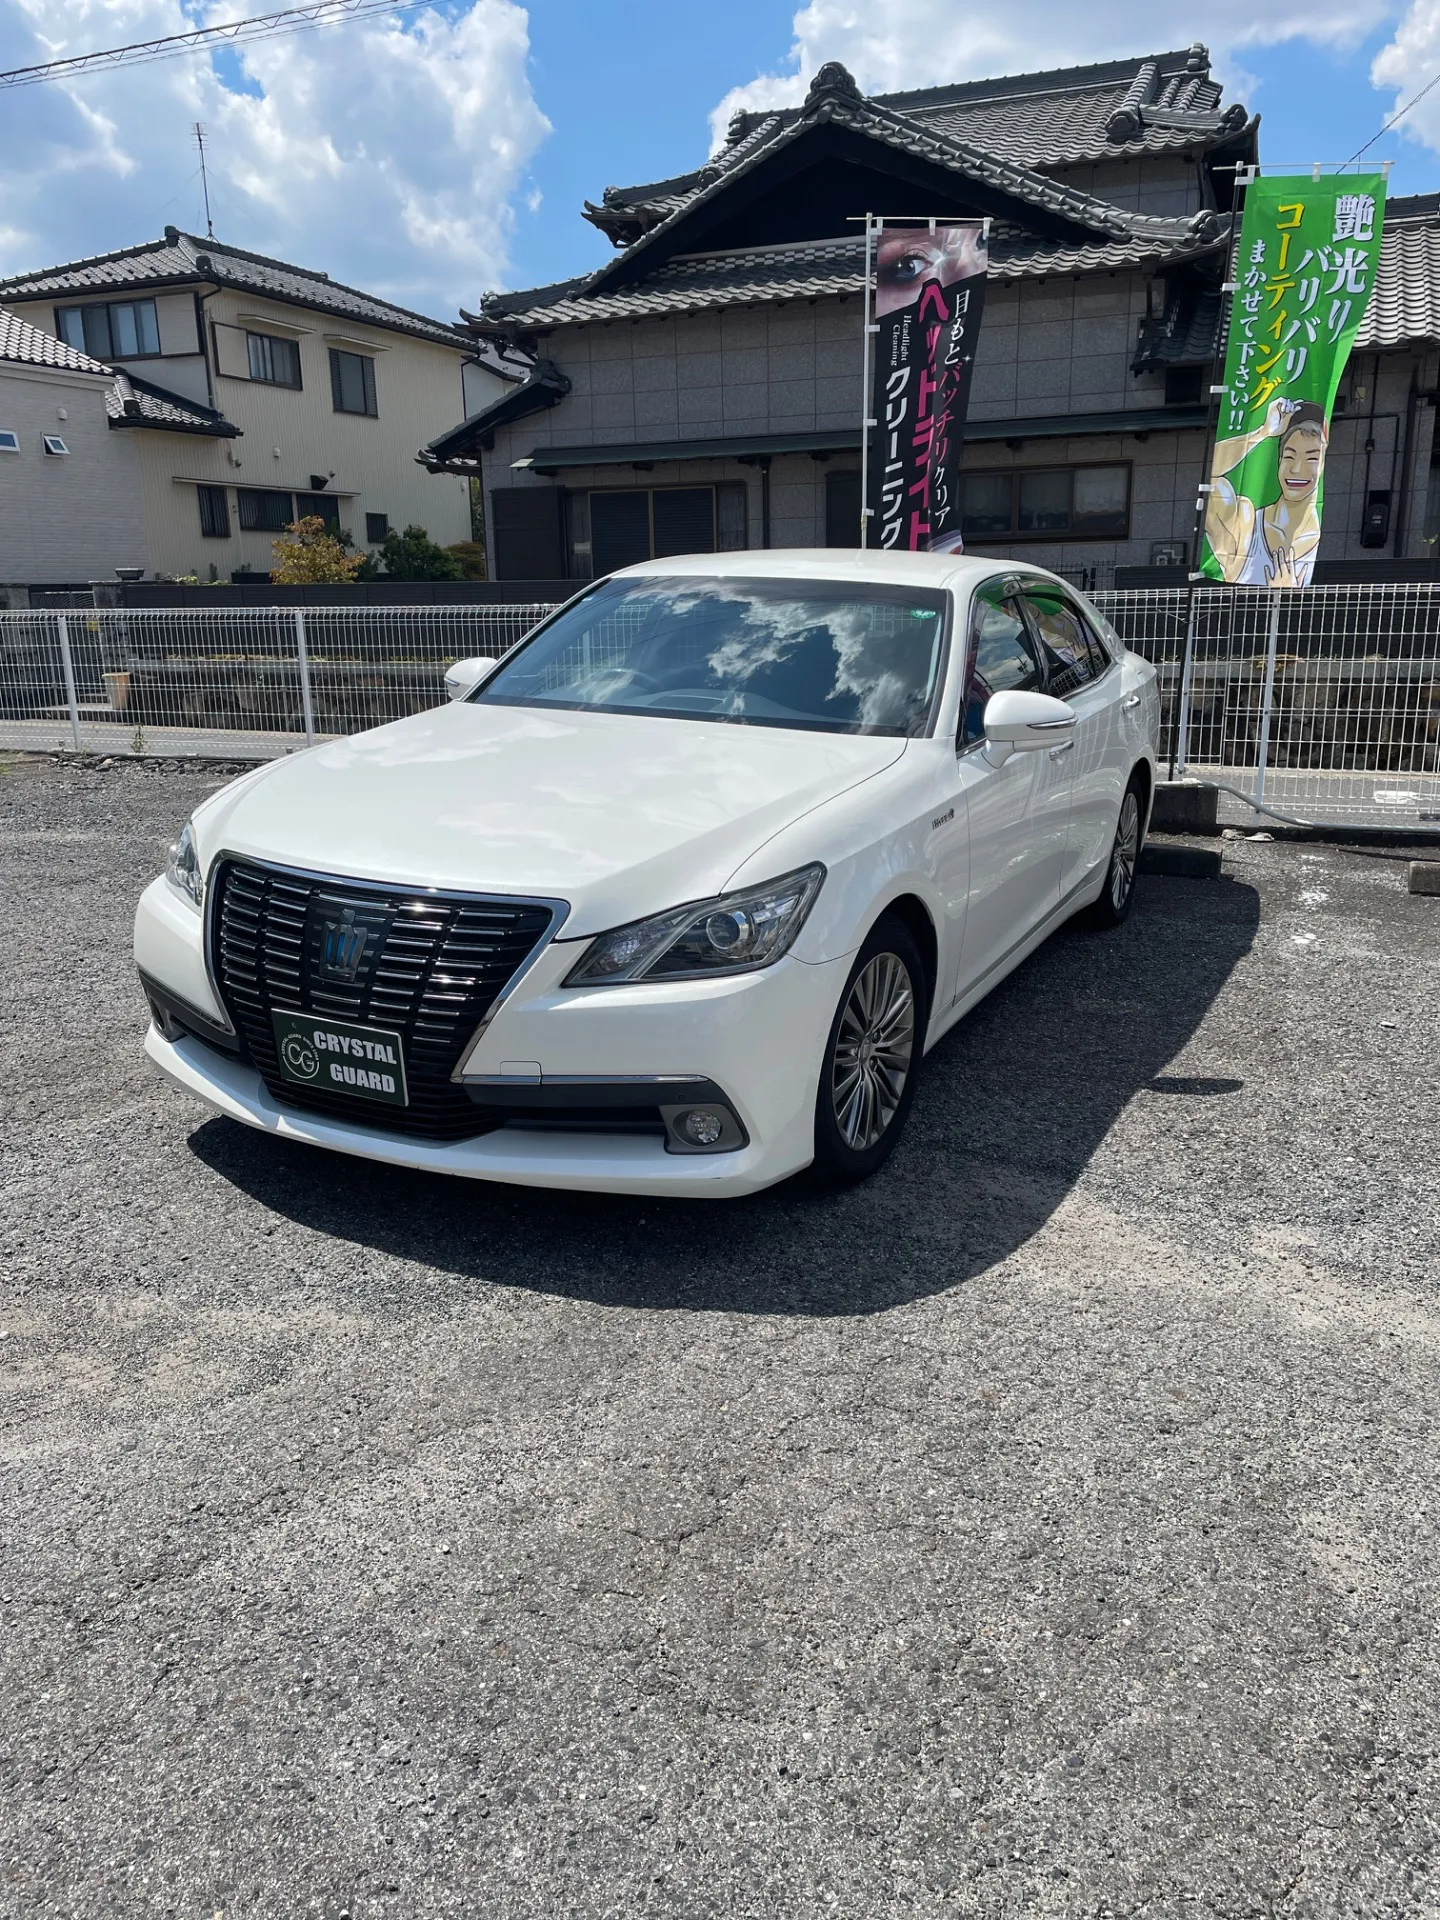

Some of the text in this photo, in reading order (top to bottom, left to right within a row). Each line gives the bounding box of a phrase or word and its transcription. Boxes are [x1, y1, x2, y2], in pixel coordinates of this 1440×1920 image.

[1248, 203, 1305, 412] コーティング
[1282, 245, 1332, 385] バリバリ
[1324, 193, 1376, 346] 艶光り
[890, 324, 900, 366] Cleaning
[901, 315, 912, 361] Headlight
[880, 367, 911, 550] クリーニング
[313, 1030, 397, 1064] CRYSTAL
[330, 1063, 396, 1093] GUARD
